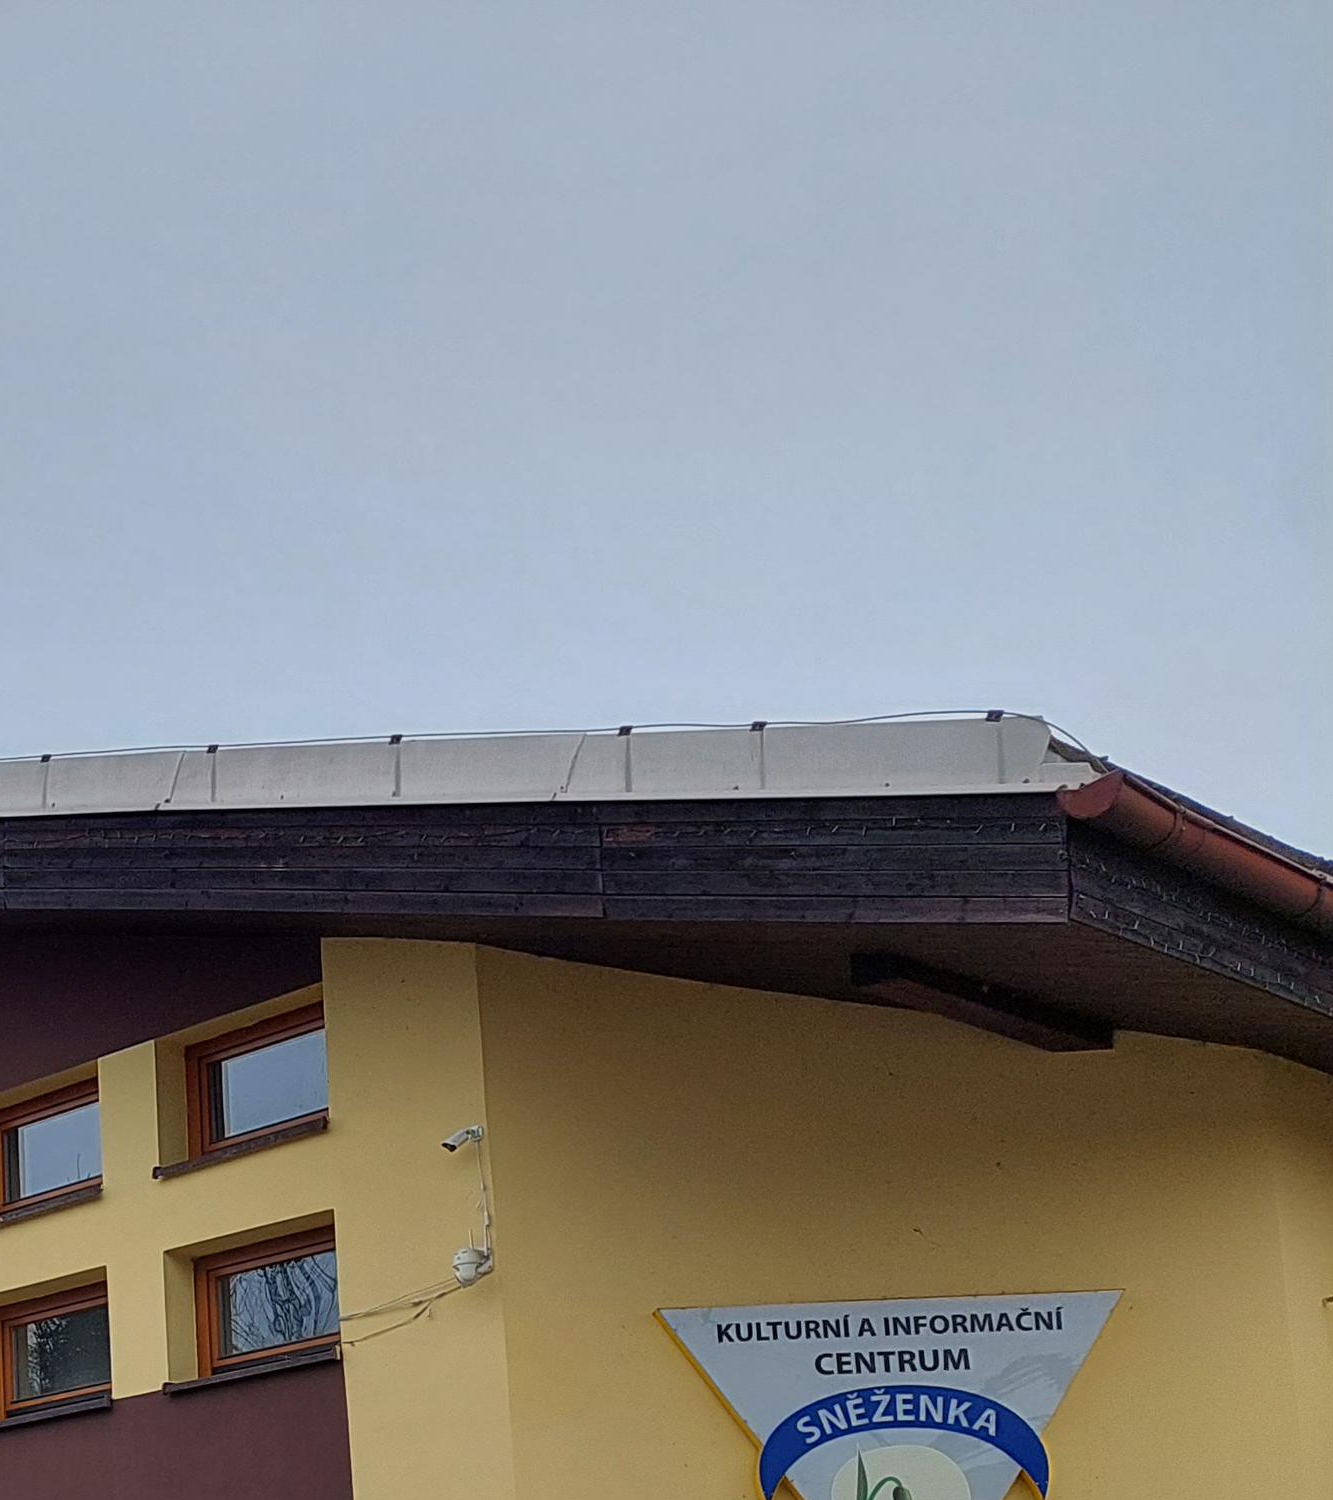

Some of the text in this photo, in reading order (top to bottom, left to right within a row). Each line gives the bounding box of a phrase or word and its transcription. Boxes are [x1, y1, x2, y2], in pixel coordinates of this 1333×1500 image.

[716, 1306, 1064, 1343] KULTURNÍ A INFORMAČNÍ
[814, 1348, 972, 1376] CENTRUM
[796, 1389, 998, 1444] SNĚŽENKA
